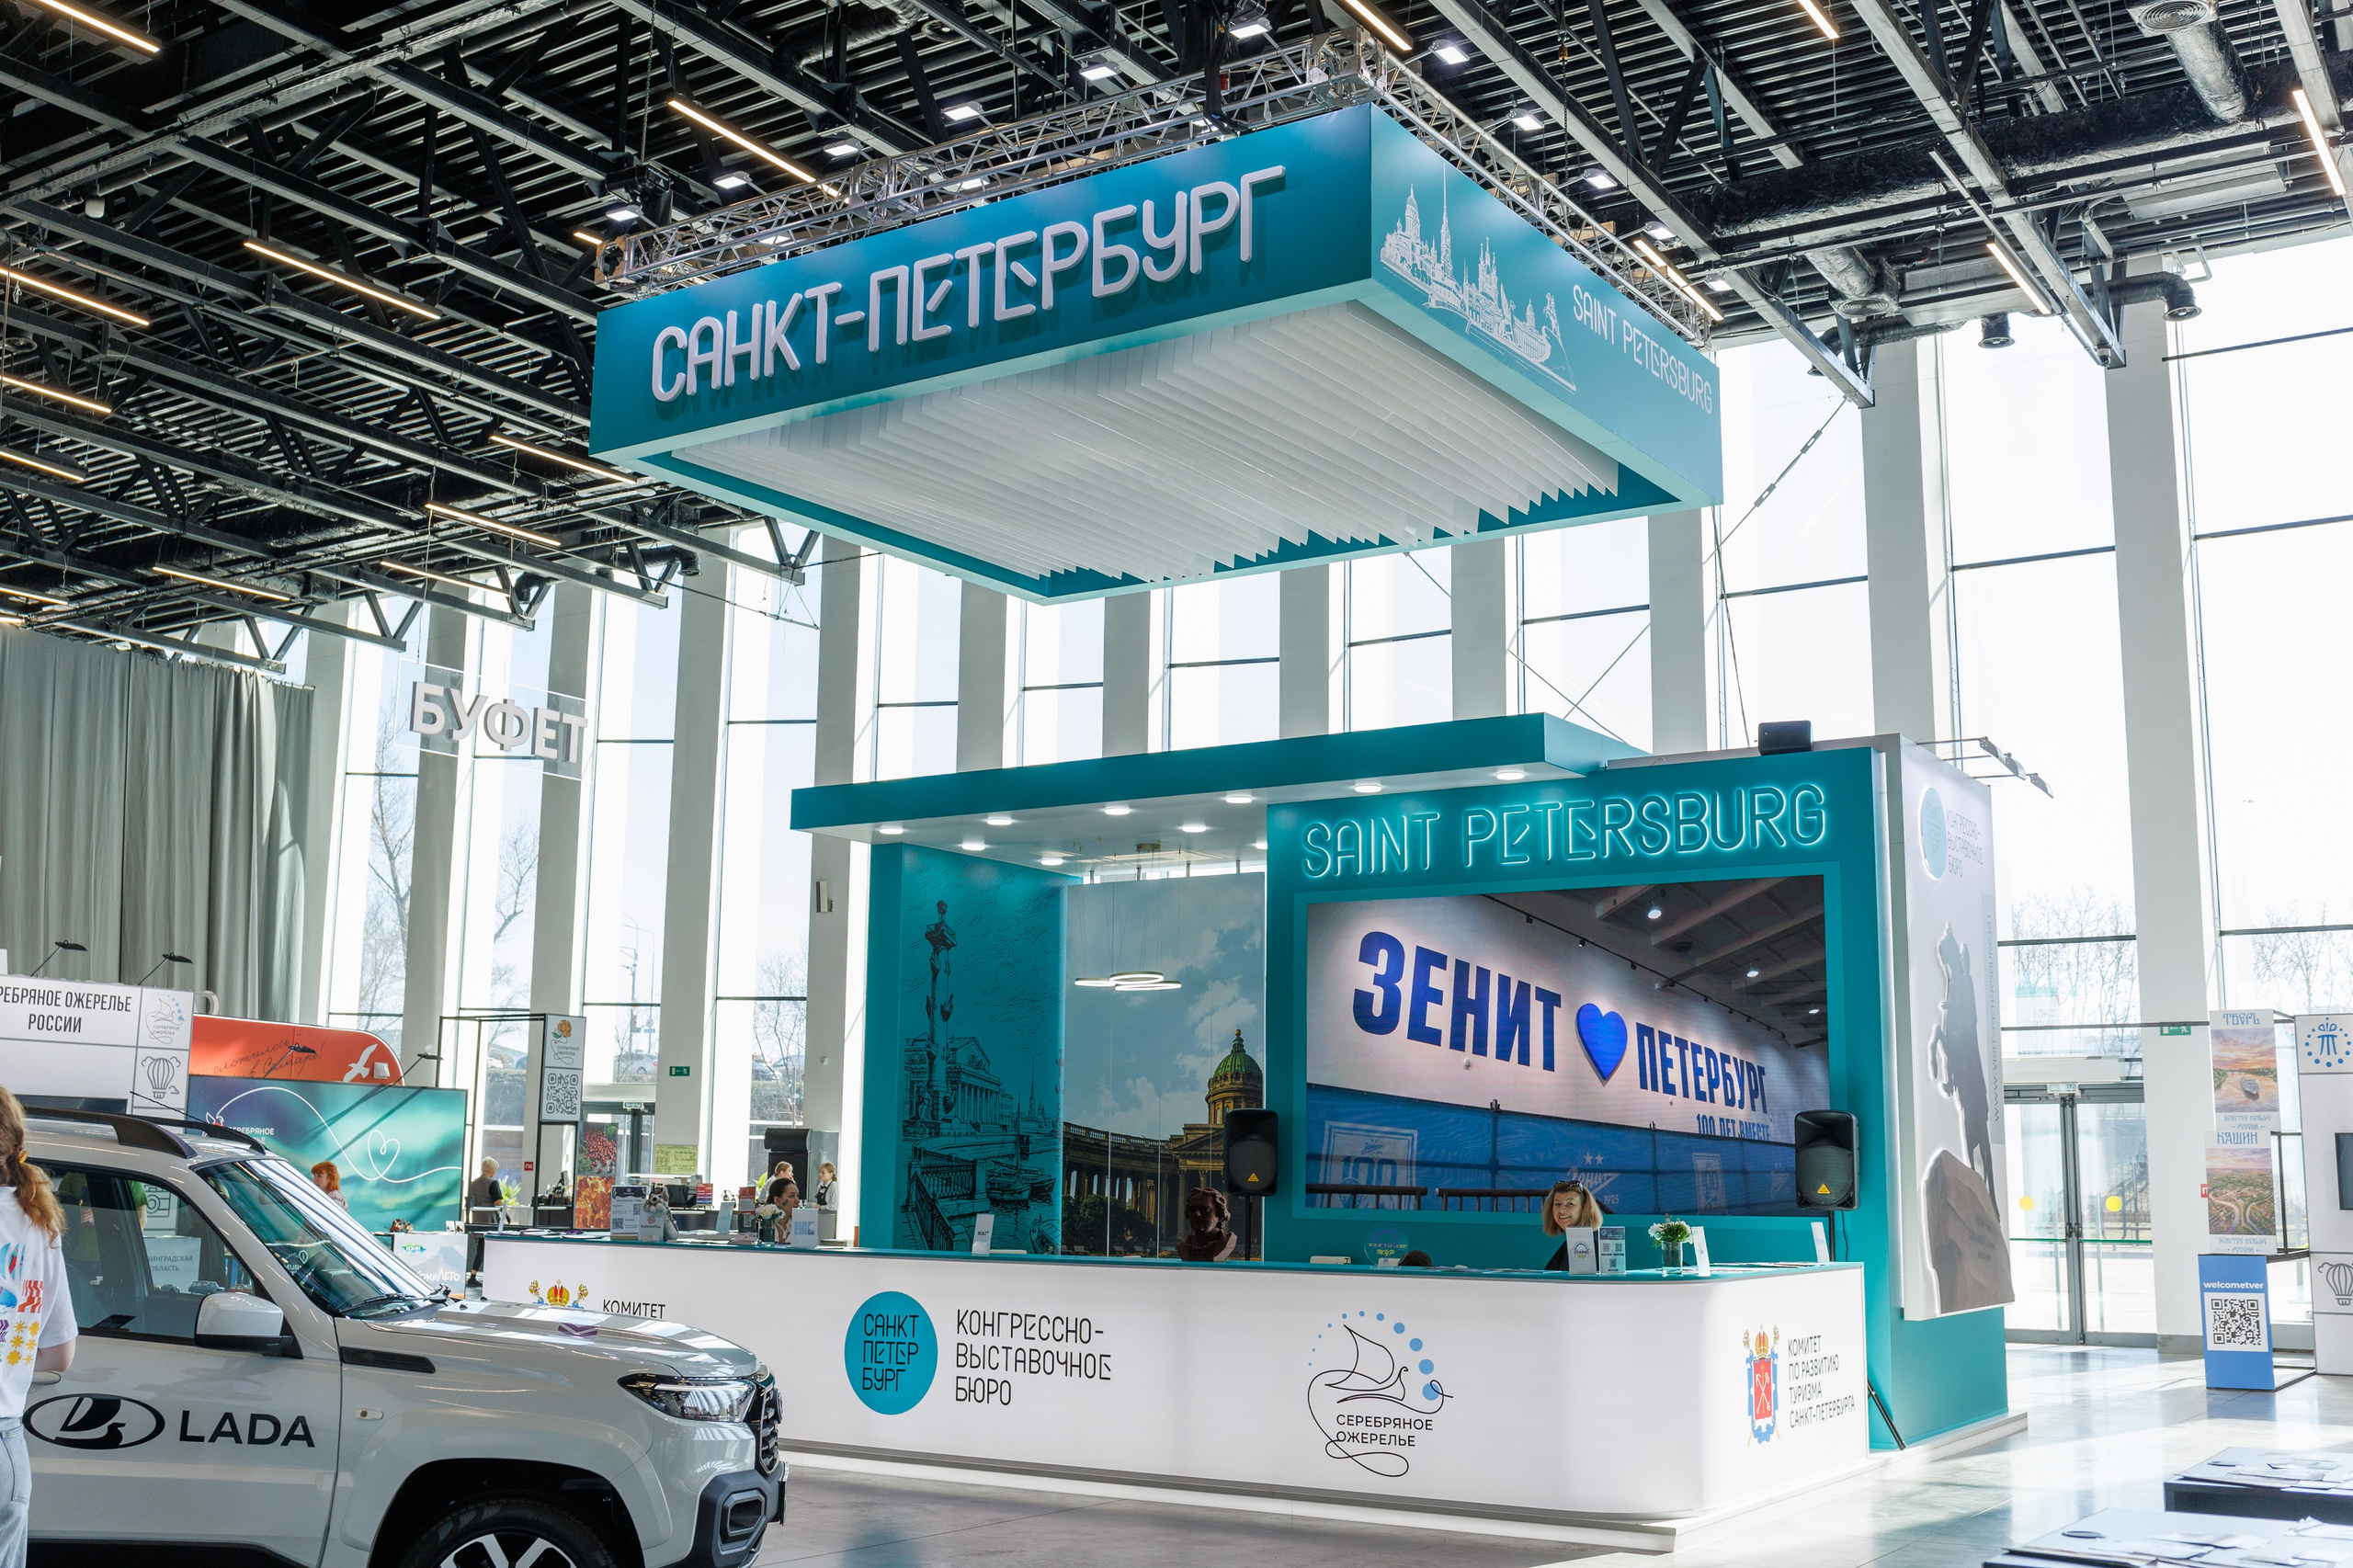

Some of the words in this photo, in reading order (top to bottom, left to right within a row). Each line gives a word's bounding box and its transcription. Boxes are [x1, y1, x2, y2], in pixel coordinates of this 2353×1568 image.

[652, 165, 1287, 403] САНКТ-ПЕТЕРБУРГ
[1573, 284, 1617, 346] SAINT
[1622, 321, 1712, 415] PETERSBURG
[409, 681, 588, 763] БУФЕТ
[1302, 812, 1441, 878] SAINT
[1462, 783, 1826, 869] PETERSBURG
[64, 991, 132, 1013] ОЖЕРЕЛЬЕ
[28, 1014, 83, 1033] РОССИИ
[1352, 930, 1562, 1073] ЗЕНИТ
[1636, 1023, 1768, 1115] ПЕТЕРБУРГ
[2222, 1012, 2260, 1026] ТВЕРЬ
[228, 1127, 275, 1135] РЕБРЯНОЕ
[1696, 1113, 1715, 1136] 100
[1738, 1119, 1770, 1142] ВМЕСТЕ
[2217, 1131, 2258, 1145] КАШИН
[1603, 1194, 1620, 1205] 1925
[2203, 1280, 2265, 1290] welcometver
[603, 1299, 666, 1319] КОМИТЕТ
[864, 1313, 919, 1338] САНКТ
[956, 1309, 1104, 1344] КОНГРЕССНО-
[863, 1340, 919, 1366] ПЕТЕР
[1788, 1335, 1822, 1358] КОМИТЕТ
[955, 1342, 1112, 1381] ВЫСТАВОЧНОЕ
[1789, 1362, 1801, 1381] ПО
[1802, 1354, 1840, 1378] РАЗВИТИЮ
[862, 1368, 906, 1392] БУРГ
[955, 1376, 1012, 1405] БЮРО
[1789, 1381, 1823, 1405] ТУРИЗМА
[1336, 1414, 1434, 1431] СЕРЕБРЯНОЕ
[1790, 1394, 1856, 1428] САНКТ-ПЕТЕРБУРГА
[178, 1409, 316, 1449] LADA
[1336, 1431, 1416, 1447] ОЖЕРЕЛЬЕ
